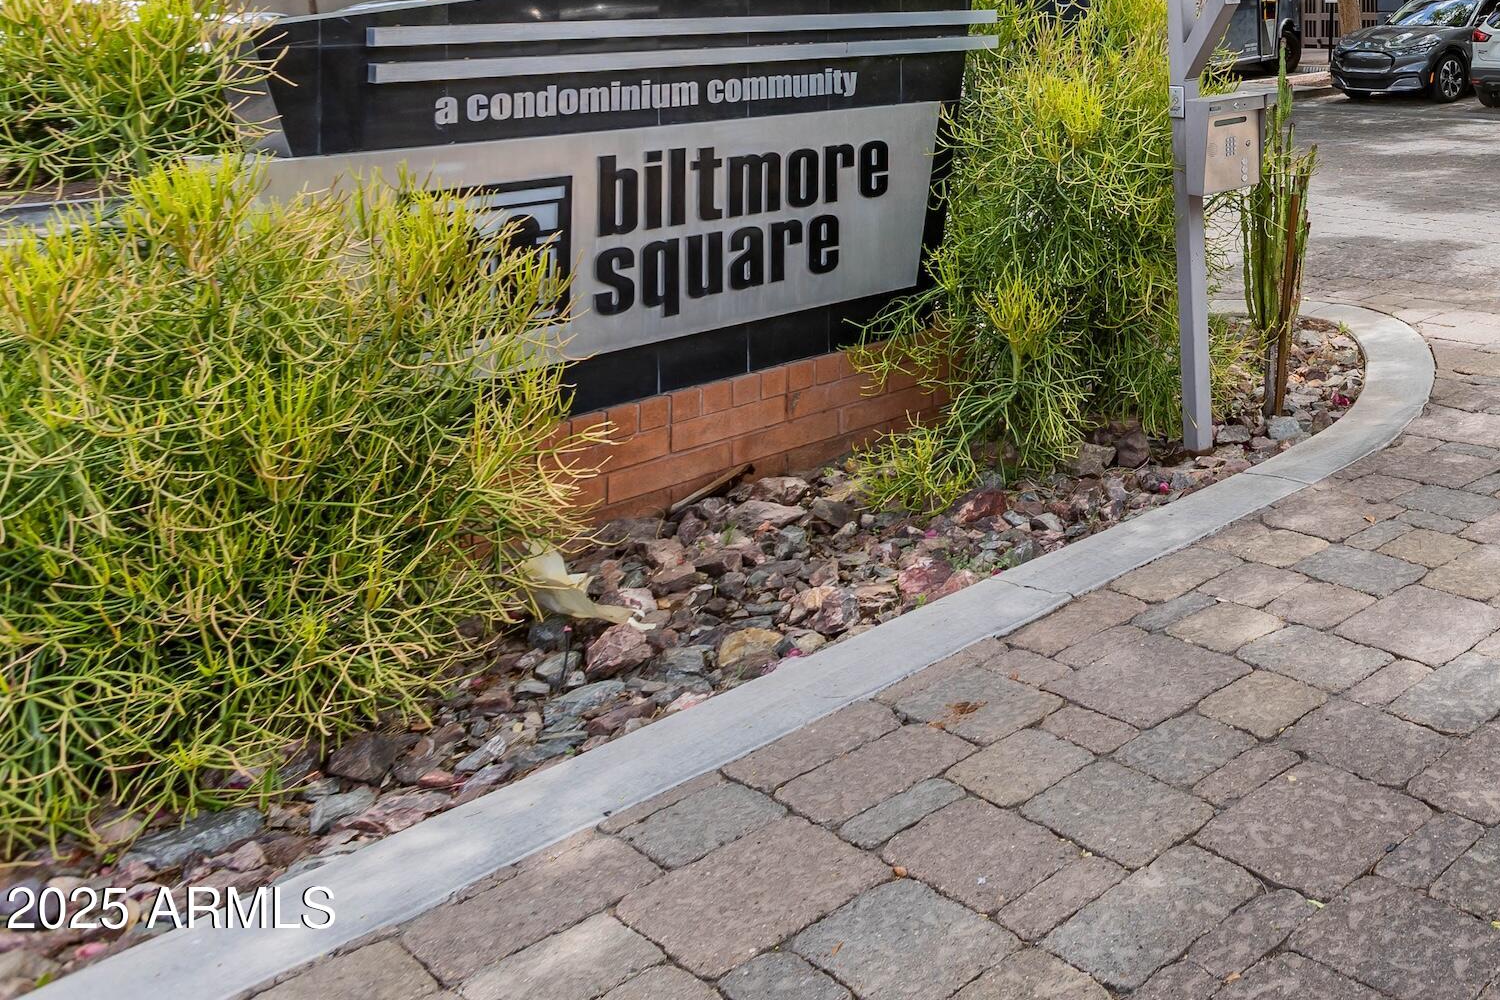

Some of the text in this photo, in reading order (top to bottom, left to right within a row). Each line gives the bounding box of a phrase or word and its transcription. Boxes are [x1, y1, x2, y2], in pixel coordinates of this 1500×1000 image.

[435, 67, 858, 125] a condominium community
[596, 140, 889, 238] biltmore
[593, 214, 840, 317] square
